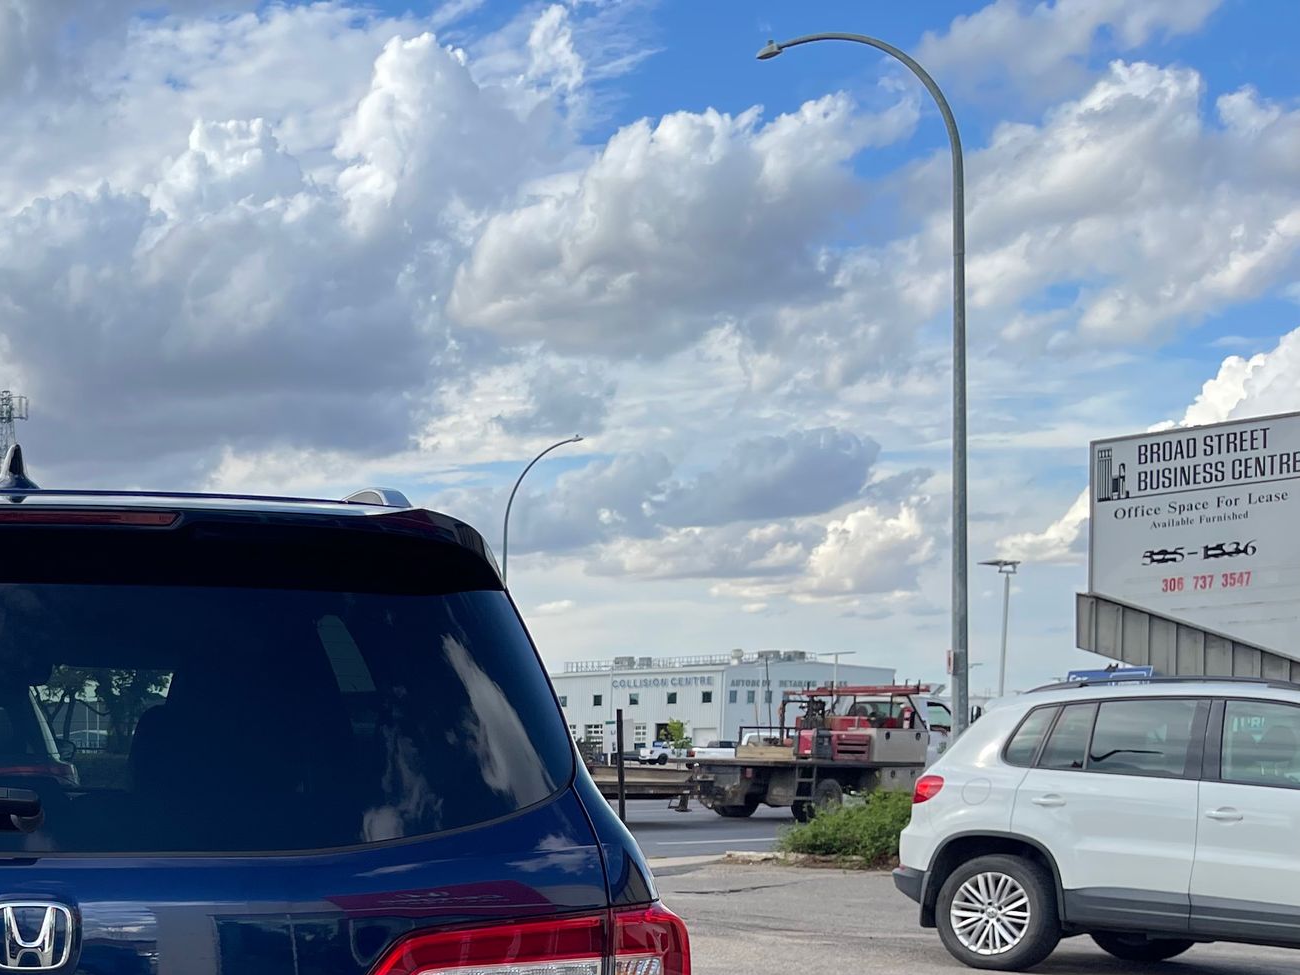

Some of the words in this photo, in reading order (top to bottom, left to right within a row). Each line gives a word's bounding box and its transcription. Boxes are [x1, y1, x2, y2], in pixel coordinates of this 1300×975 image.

[1138, 437, 1197, 465] BROAD
[1203, 428, 1270, 456] STREET
[1138, 461, 1225, 492] BUSINESS
[1232, 451, 1300, 480] CENTRE
[1114, 506, 1161, 520] Office
[1167, 500, 1209, 515] Space
[1216, 495, 1241, 508] For
[1248, 491, 1289, 505] Lease
[1150, 518, 1195, 530] Available
[1199, 510, 1249, 524] Furnished
[1162, 577, 1184, 592] 306
[1193, 575, 1214, 590] 737
[1221, 571, 1252, 588] 3547
[612, 678, 667, 689] COLLISION
[670, 676, 714, 687] CENTRE
